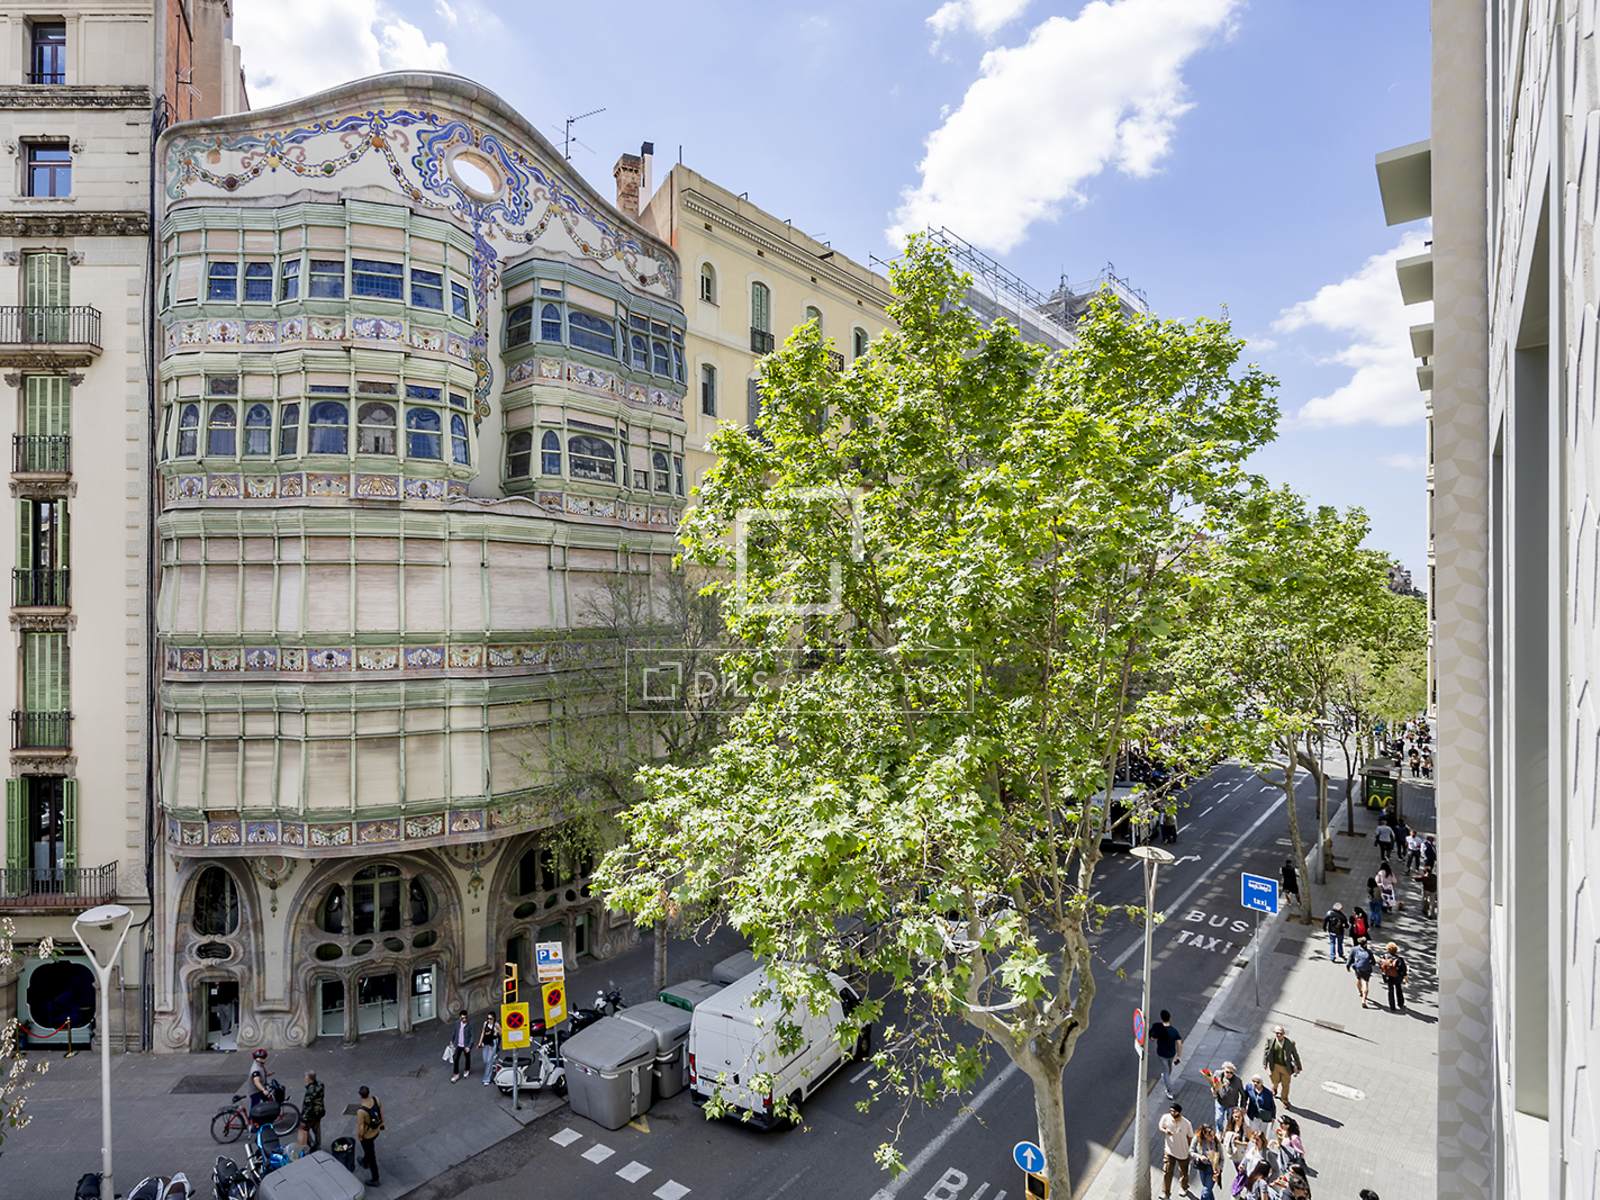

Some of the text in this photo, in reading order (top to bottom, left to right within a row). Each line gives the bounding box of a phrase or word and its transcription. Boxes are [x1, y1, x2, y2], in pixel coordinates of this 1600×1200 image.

[1253, 897, 1267, 907] taxi
[1184, 910, 1250, 933] BUS
[1177, 930, 1234, 955] TAXI
[540, 950, 548, 961] P
